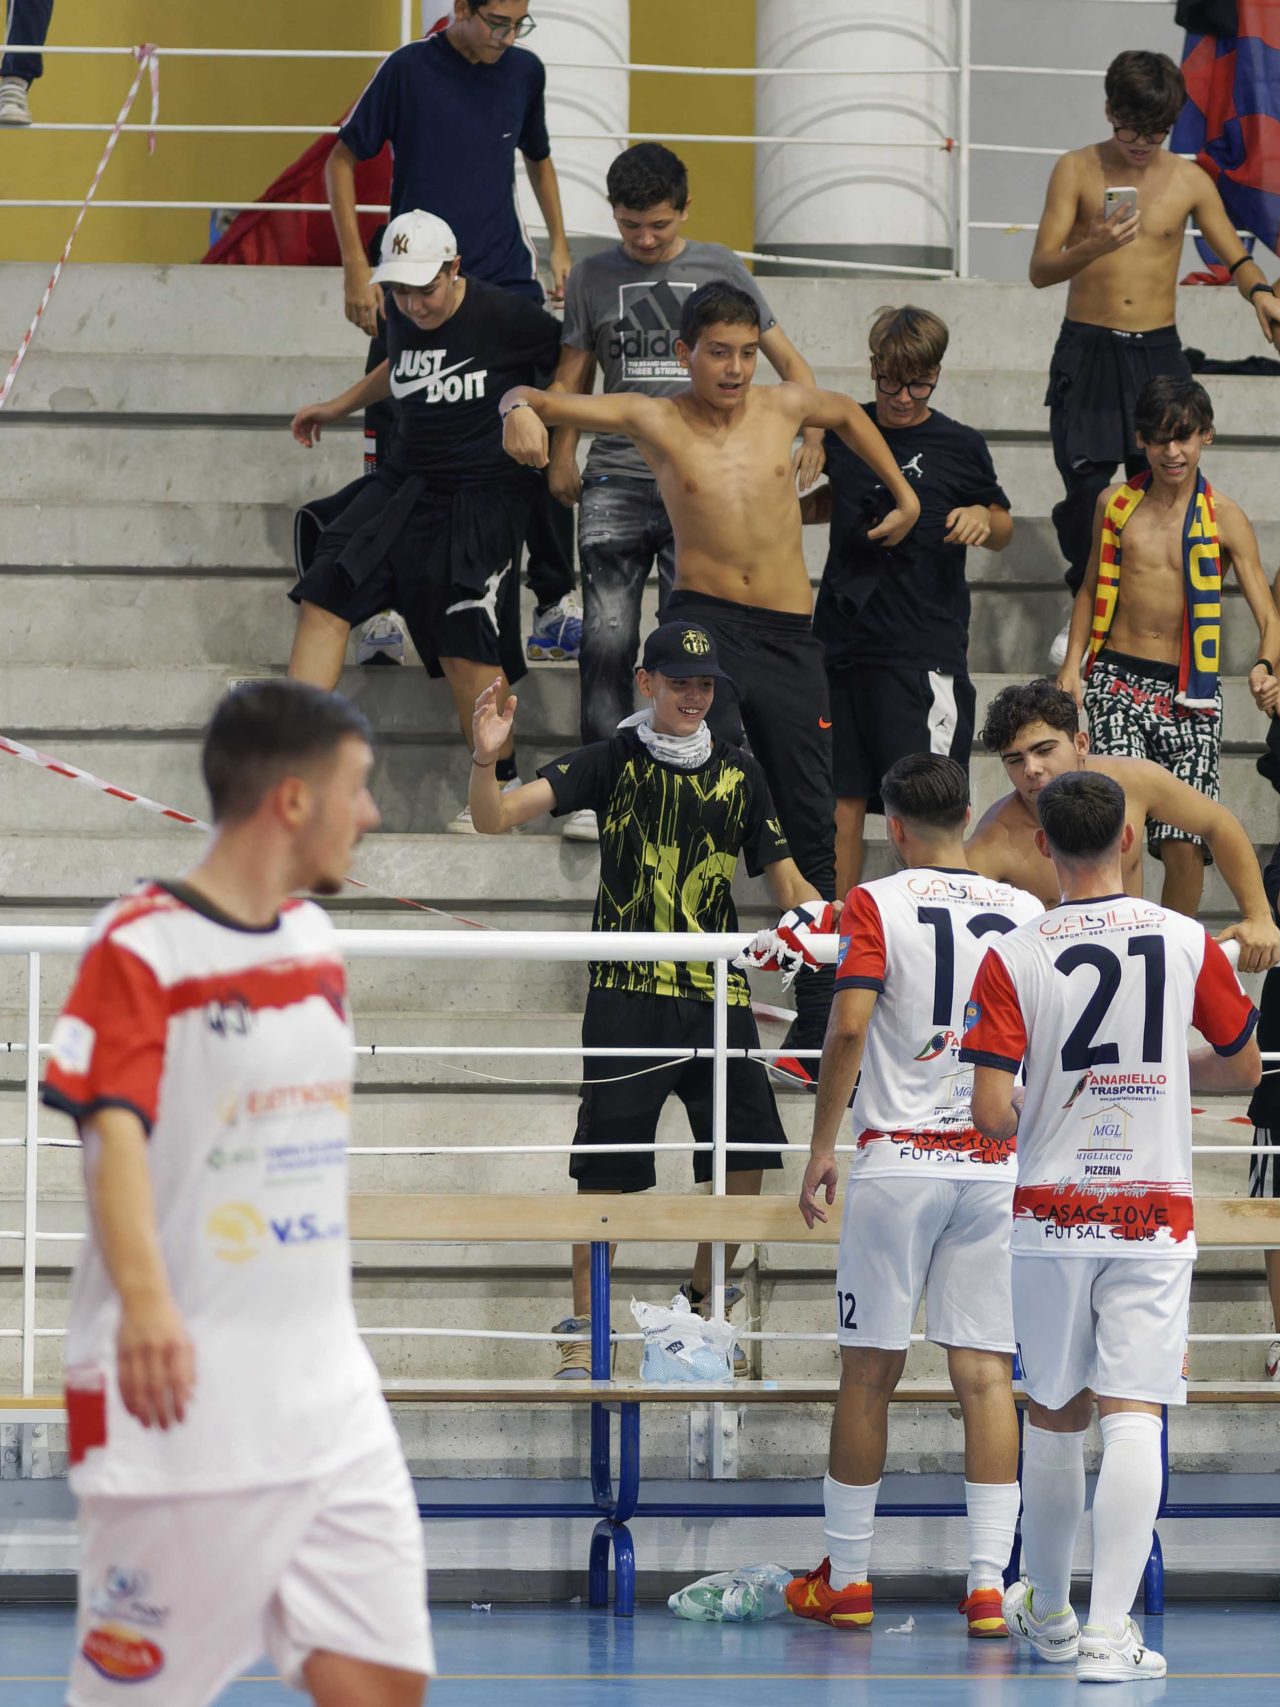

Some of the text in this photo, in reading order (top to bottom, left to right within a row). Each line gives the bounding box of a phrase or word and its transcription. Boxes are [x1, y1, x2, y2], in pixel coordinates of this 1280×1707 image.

[396, 349, 447, 378] JUST
[1053, 934, 1166, 1072] 21
[1089, 1085, 1156, 1096] TRASPORTI
[1092, 1124, 1123, 1137] MGL
[900, 1147, 965, 1163] FUTSAL
[1084, 1165, 1121, 1176] PIZZERIA
[1032, 1203, 1169, 1226] CASAGIOVE
[1044, 1225, 1157, 1242] FUTSAL CLUB
[837, 1290, 858, 1330] 12
